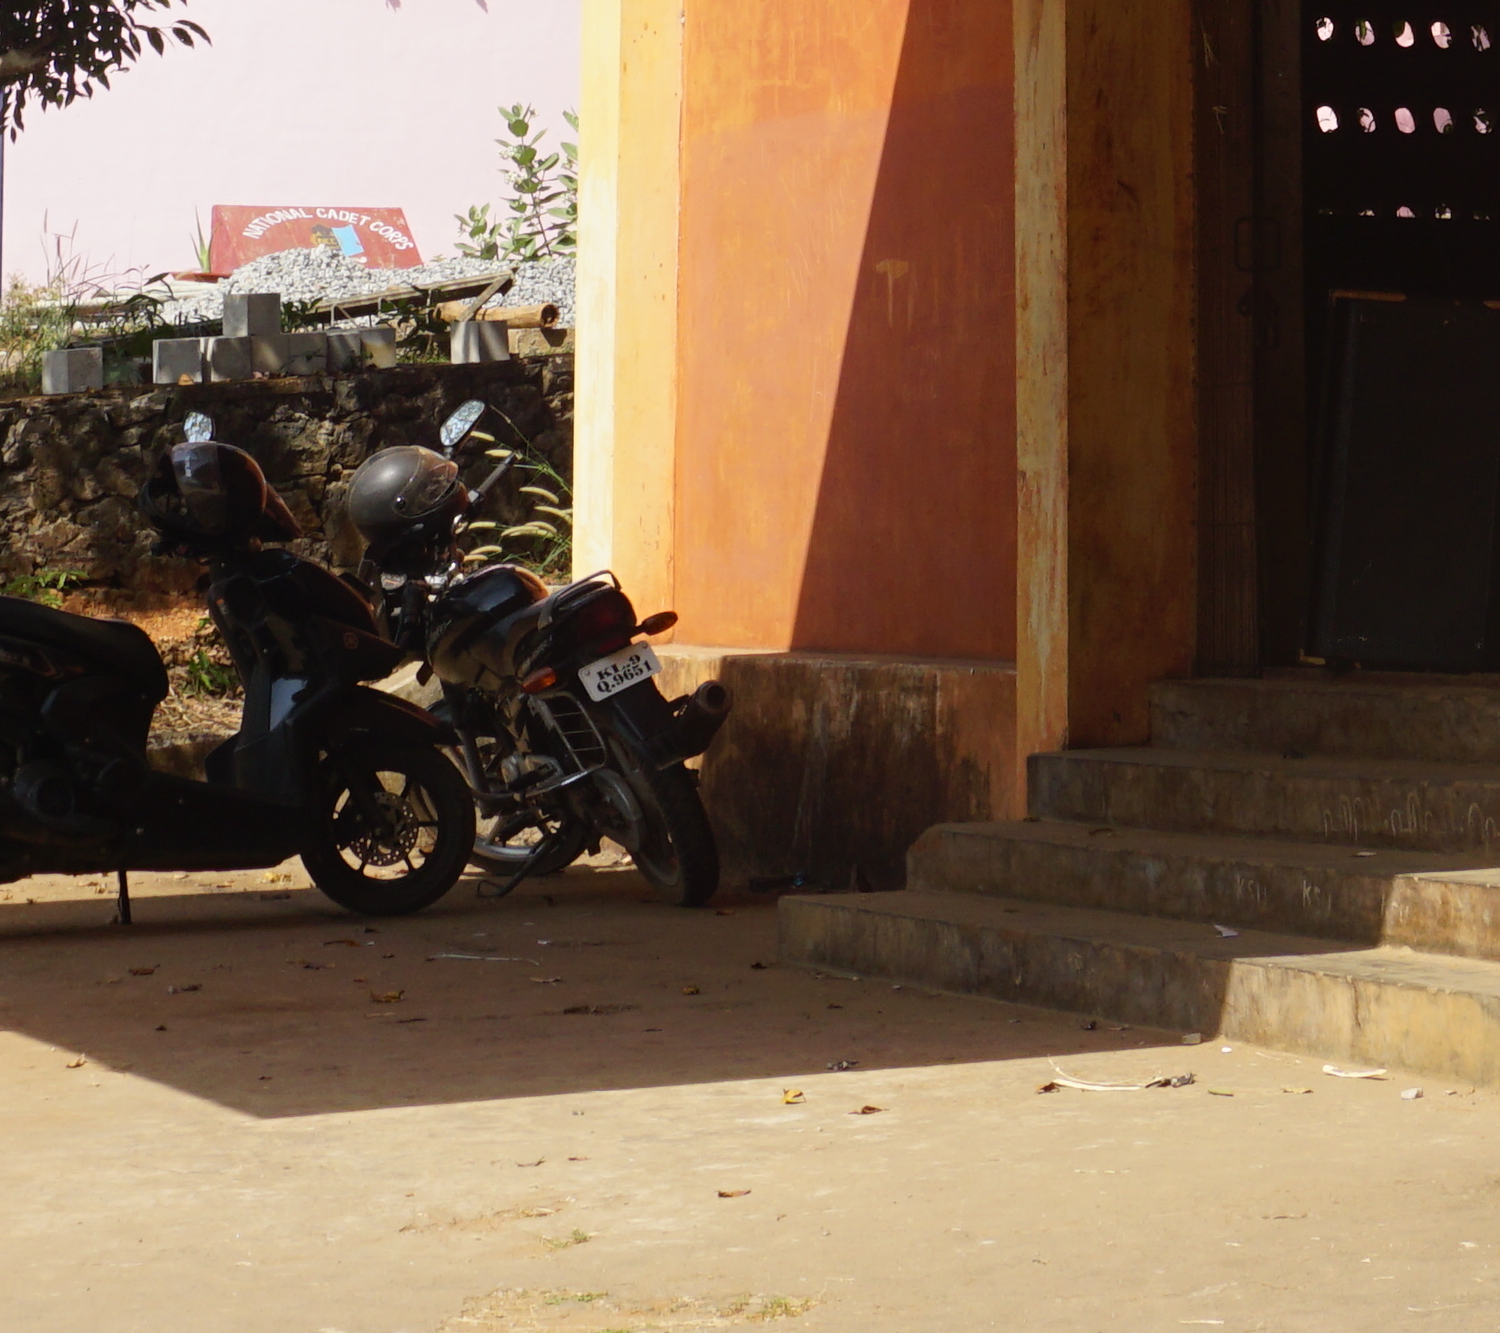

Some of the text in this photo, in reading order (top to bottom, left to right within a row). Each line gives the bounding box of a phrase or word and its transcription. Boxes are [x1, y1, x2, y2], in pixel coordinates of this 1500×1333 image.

[242, 207, 314, 240] NATIONAL
[315, 207, 372, 227] CADET
[369, 220, 414, 251] CORPS
